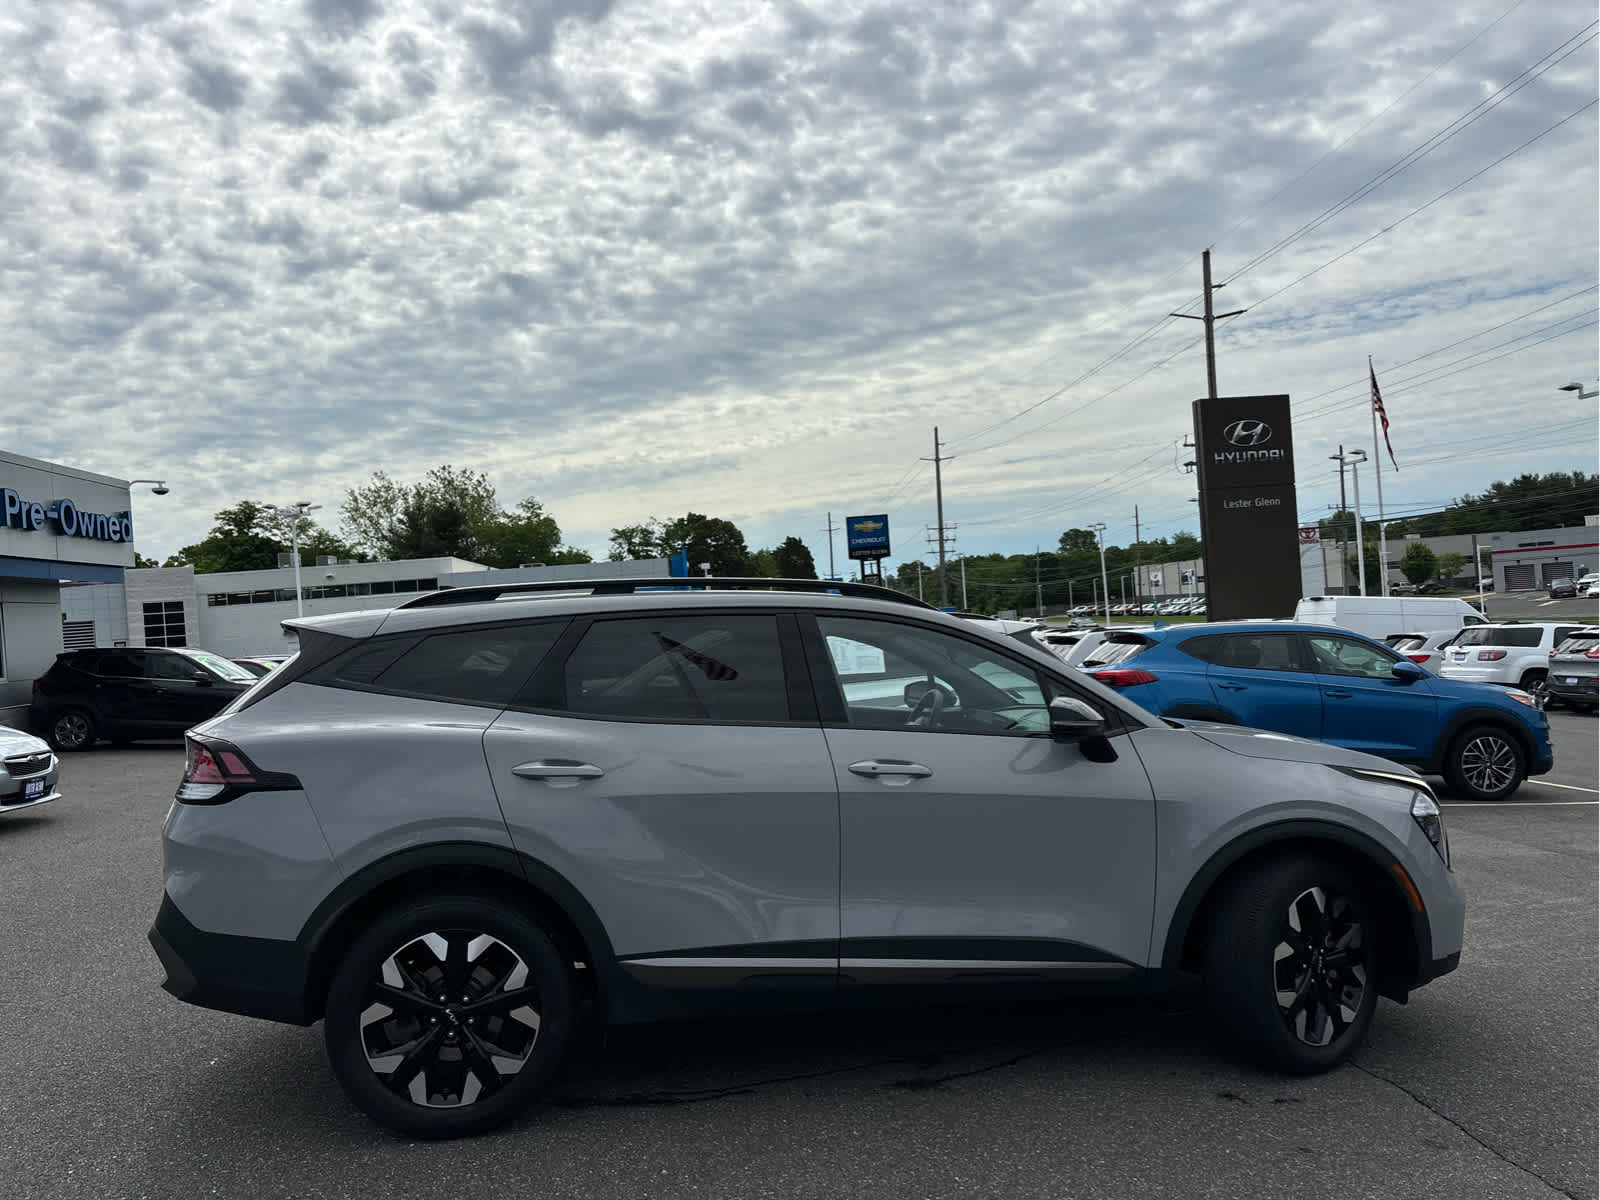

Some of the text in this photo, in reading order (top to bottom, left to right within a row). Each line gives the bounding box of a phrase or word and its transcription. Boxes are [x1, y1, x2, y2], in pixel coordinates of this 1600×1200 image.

[1214, 449, 1284, 463] HYUNDAI
[1223, 496, 1281, 509] Lester Glenn
[3, 488, 132, 542] Pre-Owned
[852, 536, 887, 545] CHEVROLET
